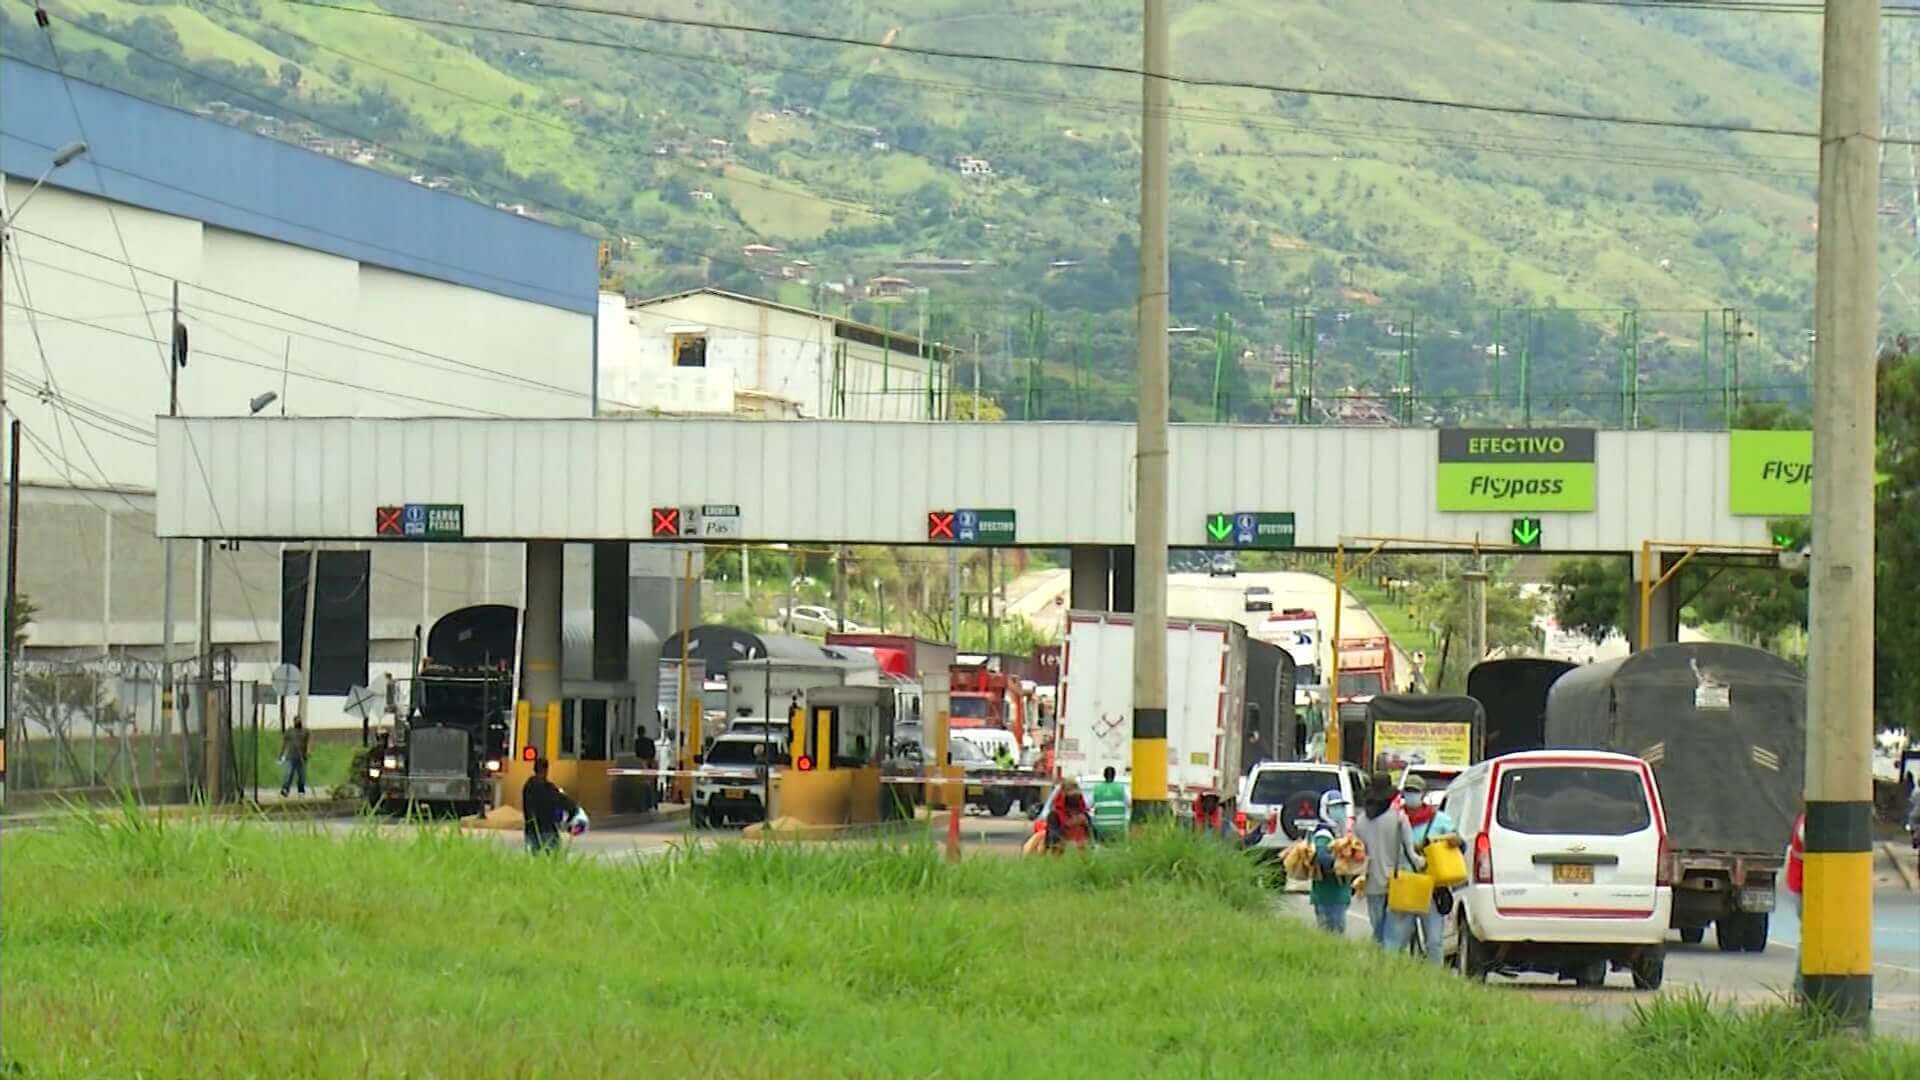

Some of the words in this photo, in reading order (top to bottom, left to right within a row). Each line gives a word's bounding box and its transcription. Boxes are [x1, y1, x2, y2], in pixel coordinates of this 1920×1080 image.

[1469, 437, 1565, 453] EFECTIVO
[1762, 461, 1813, 484] Flyp
[1469, 475, 1563, 499] Flypass
